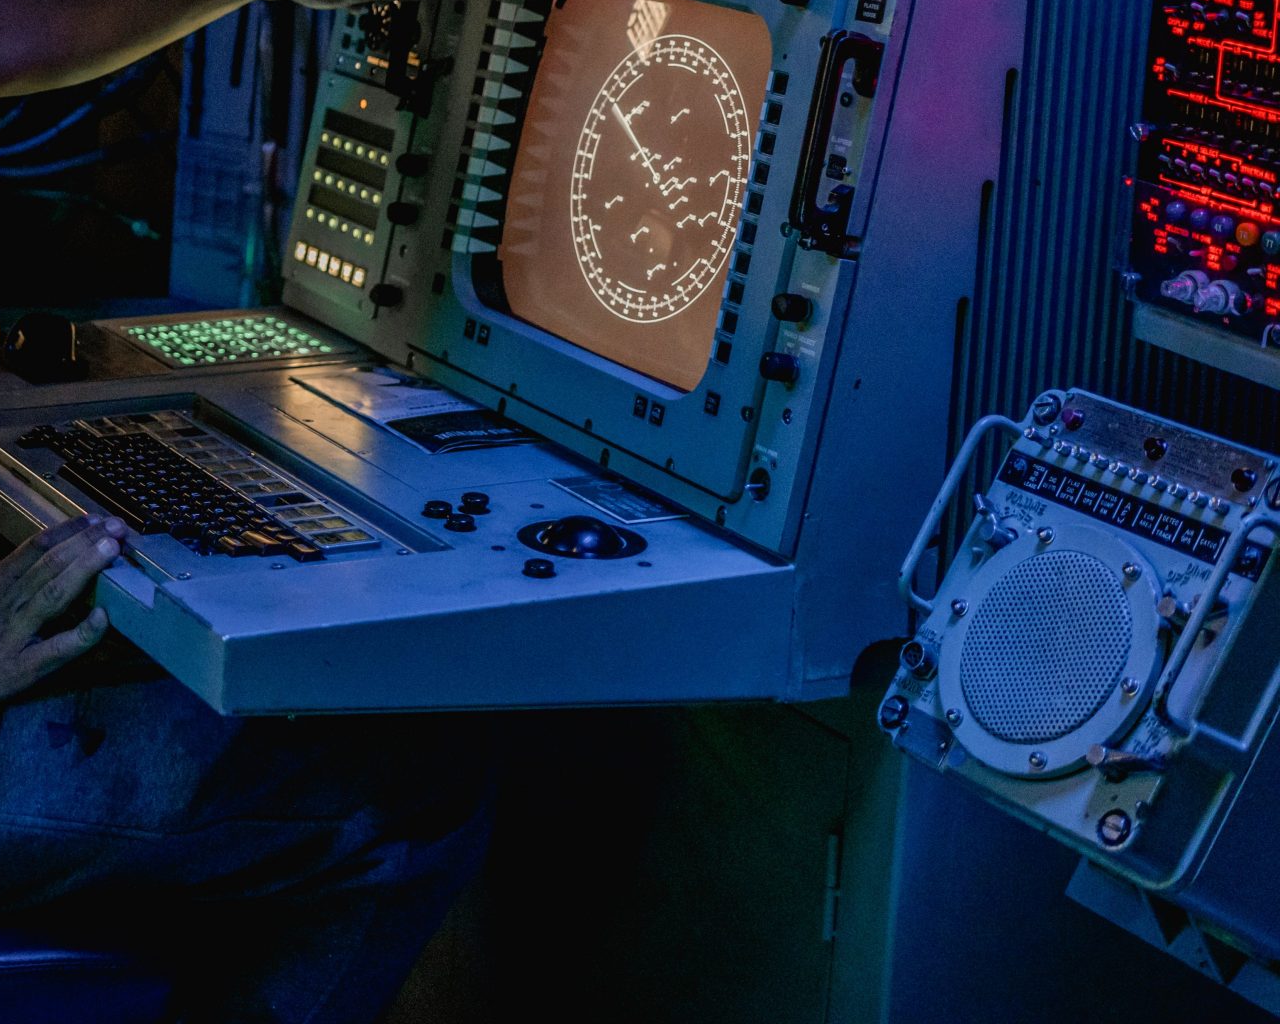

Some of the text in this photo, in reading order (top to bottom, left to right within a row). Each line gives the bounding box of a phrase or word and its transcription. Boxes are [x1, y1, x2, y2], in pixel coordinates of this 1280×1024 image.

[1238, 0, 1255, 10] TEST
[1167, 17, 1190, 29] DISPLAY
[1199, 145, 1220, 157] SELECT
[1155, 529, 1171, 541] TRACK
